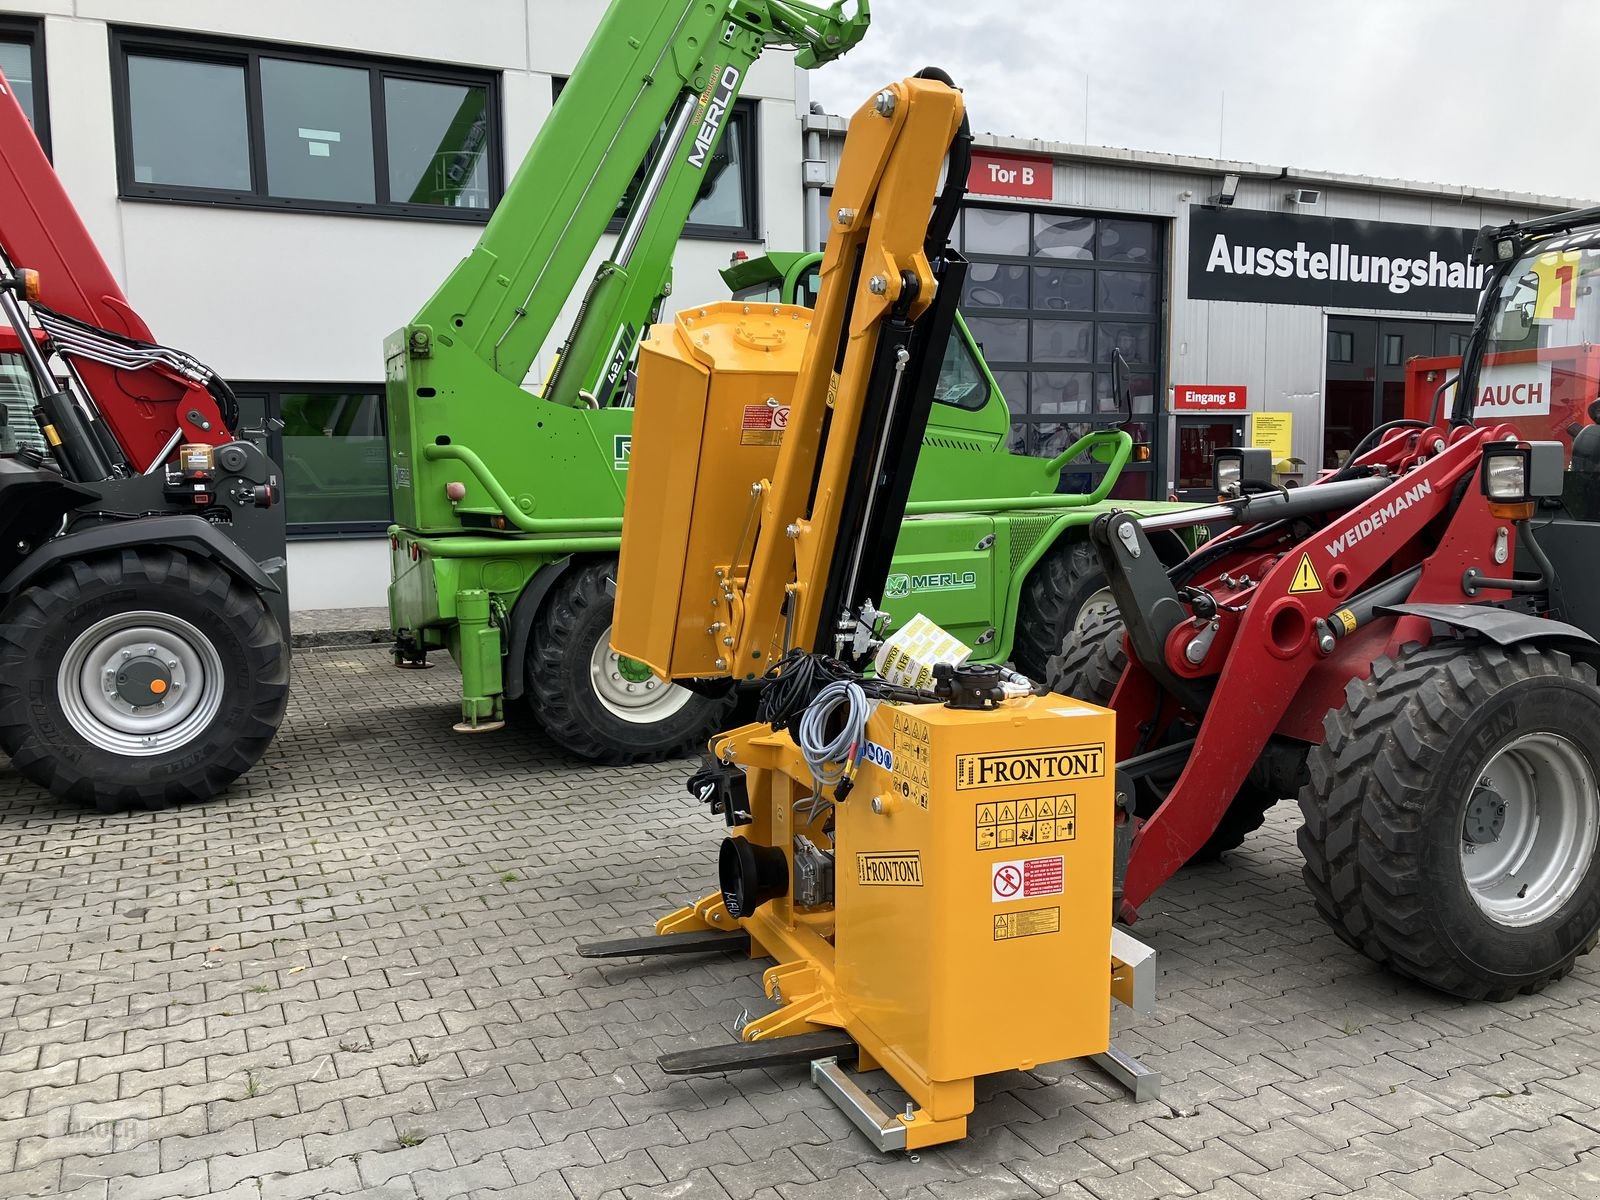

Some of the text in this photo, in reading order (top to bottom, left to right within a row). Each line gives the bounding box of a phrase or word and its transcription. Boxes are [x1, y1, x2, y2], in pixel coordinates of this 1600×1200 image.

[687, 65, 740, 168] MERLO
[987, 163, 1034, 185] Tor B
[1206, 233, 1494, 294] Ausstellungshall
[1552, 265, 1576, 321] 1
[607, 349, 625, 384] 42.7
[1185, 391, 1236, 405] Eingang B
[1325, 478, 1432, 558] WEIDEMANN
[912, 572, 976, 588] MERLO
[977, 750, 1101, 783] FRONTONI
[865, 857, 920, 882] FRONTONI
